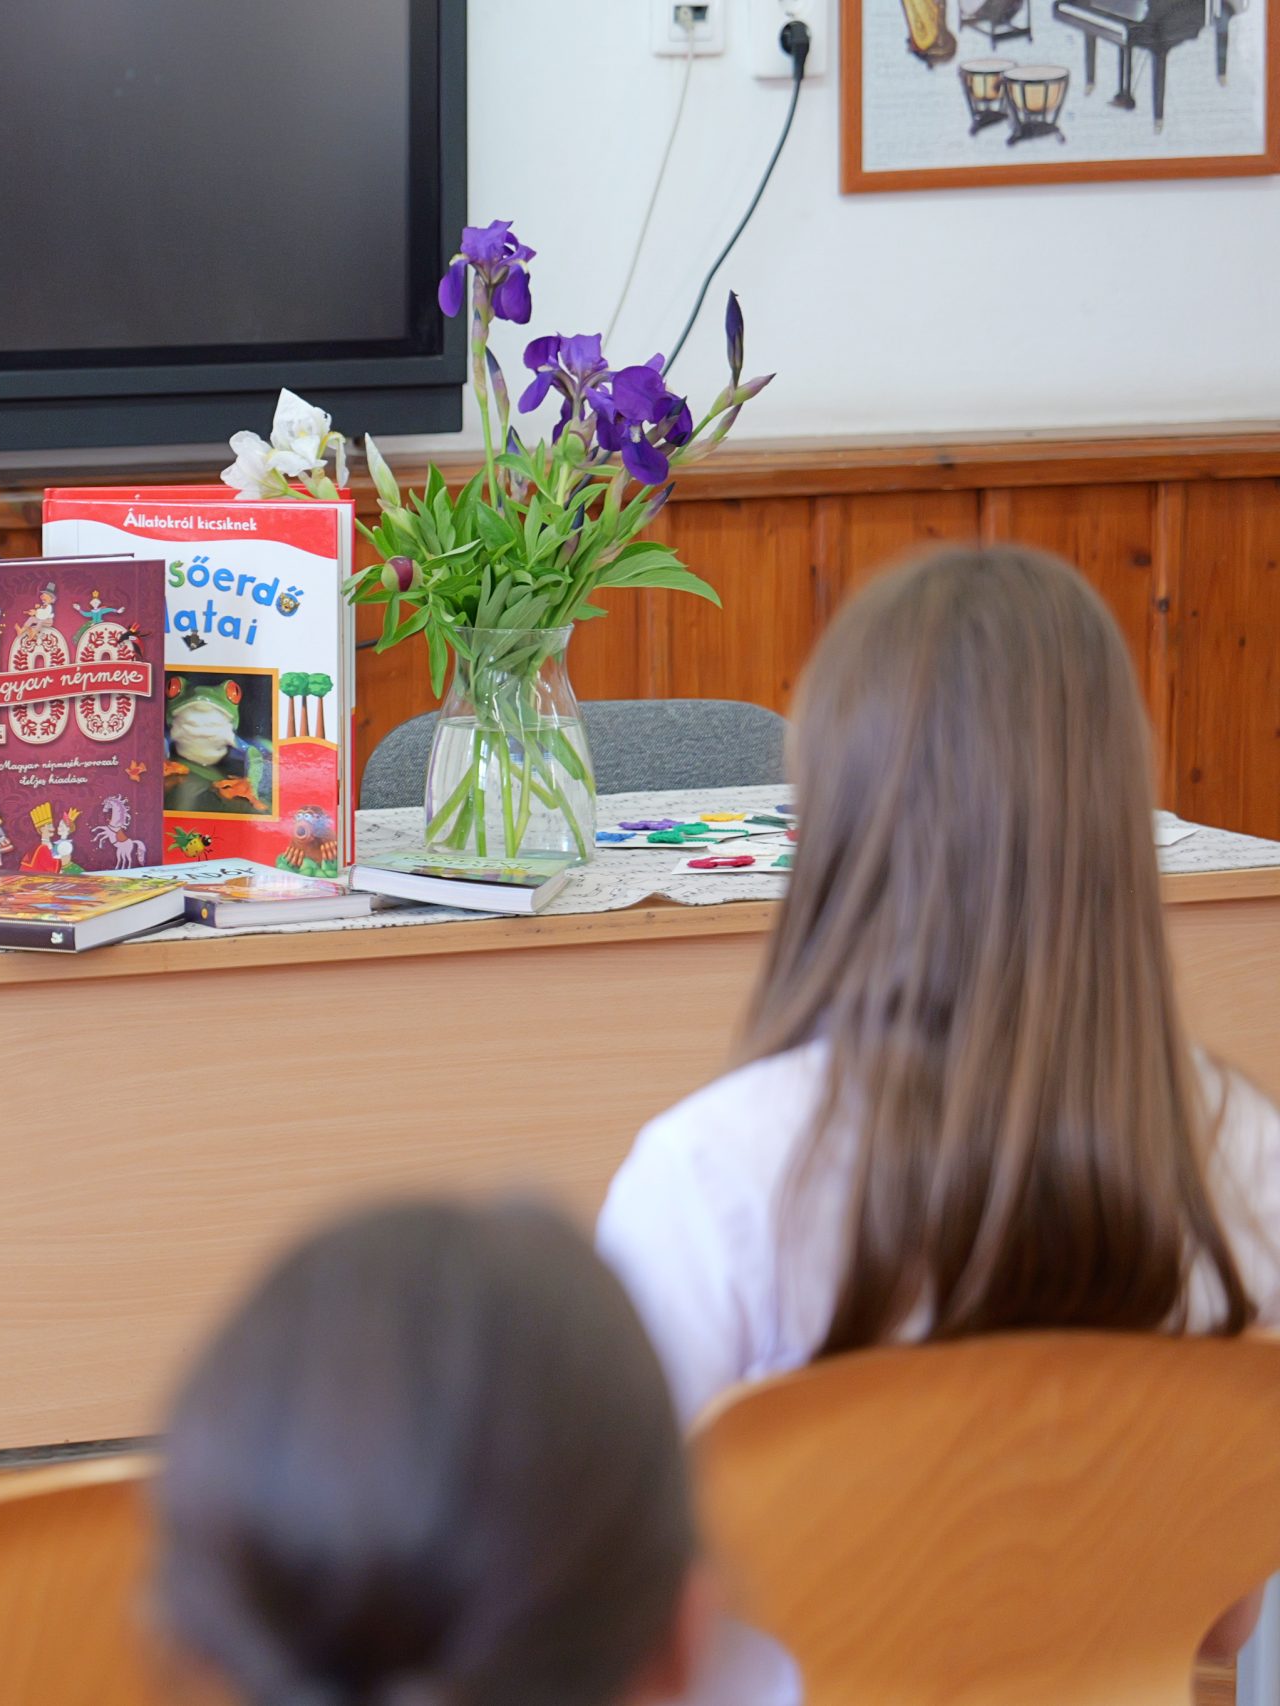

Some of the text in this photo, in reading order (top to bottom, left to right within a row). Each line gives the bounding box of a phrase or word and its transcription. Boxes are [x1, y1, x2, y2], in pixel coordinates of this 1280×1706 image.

[123, 508, 257, 531] Állatokról kicsiknek
[61, 667, 143, 690] népmese
[49, 773, 88, 784] kiadása
